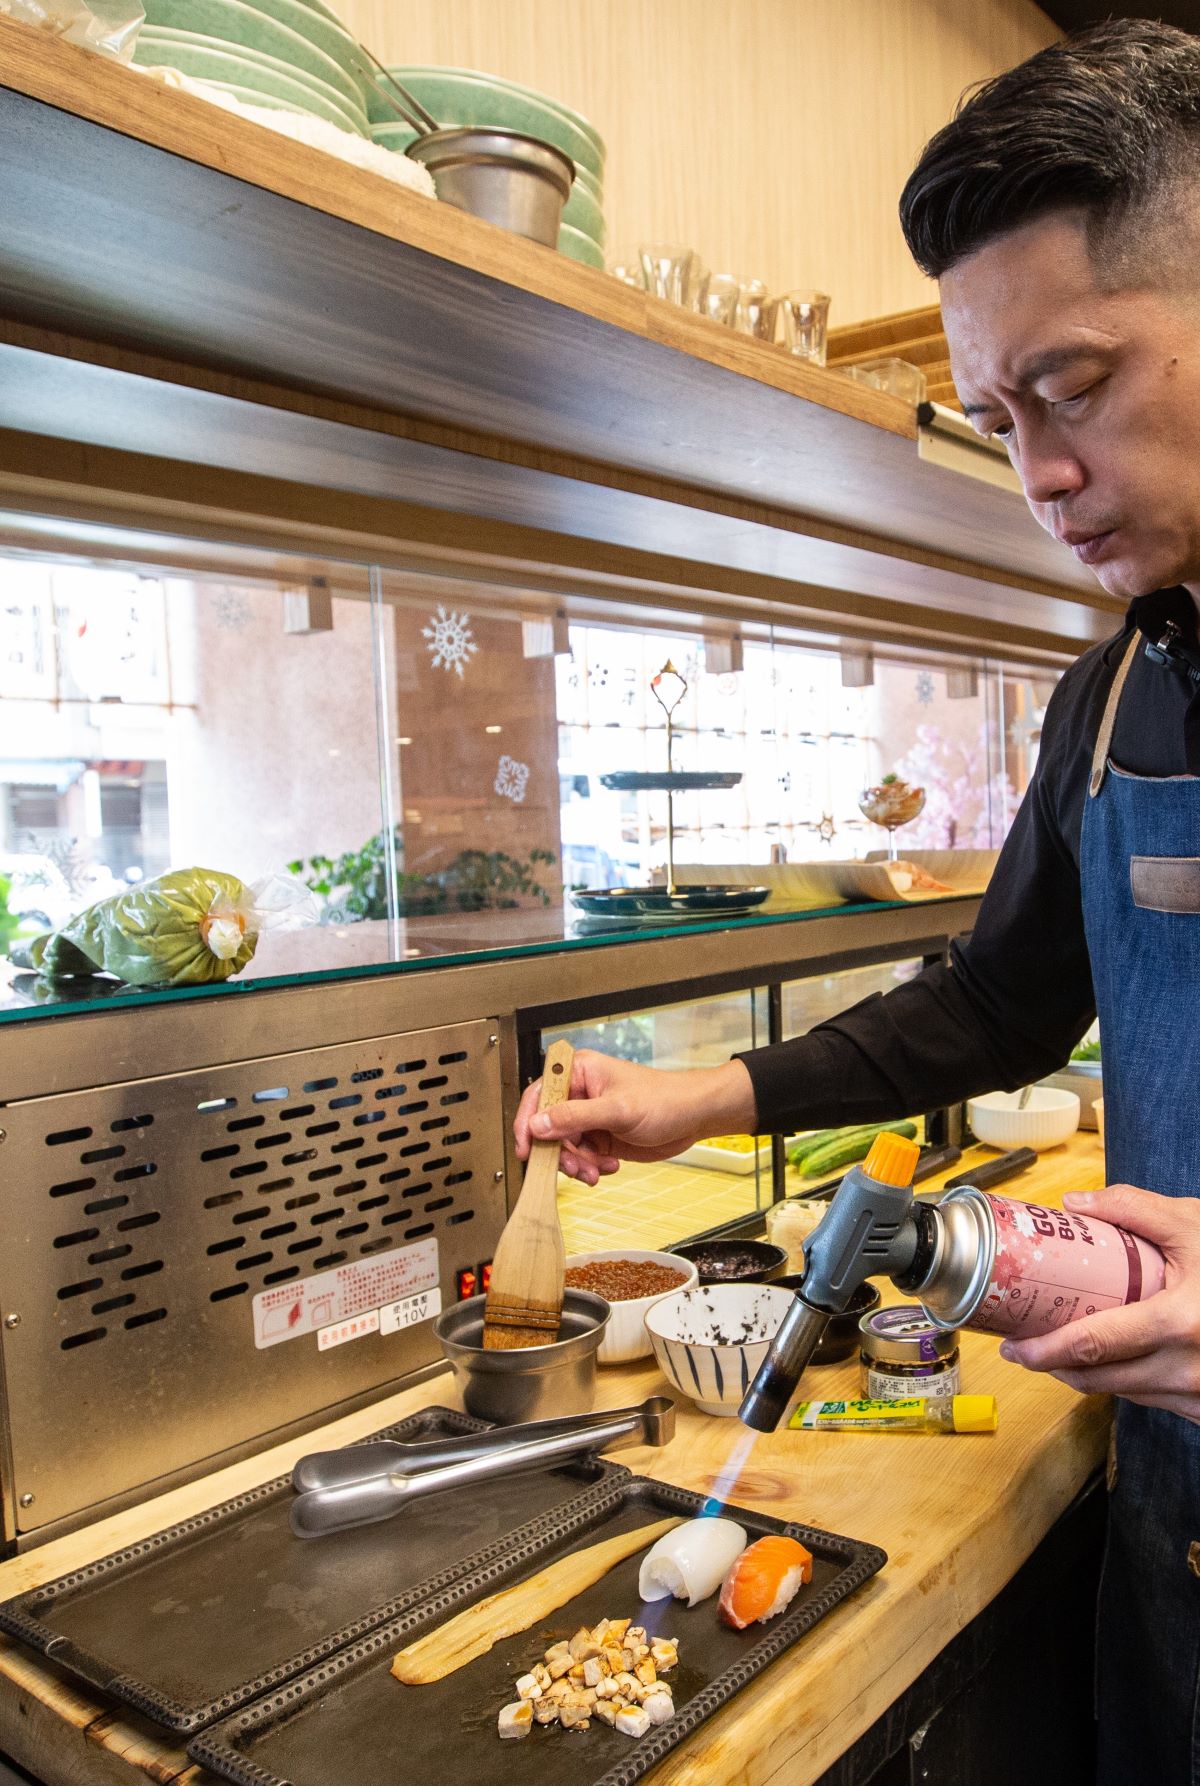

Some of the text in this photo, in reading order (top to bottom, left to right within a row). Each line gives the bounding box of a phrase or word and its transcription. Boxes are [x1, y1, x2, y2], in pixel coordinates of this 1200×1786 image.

[1026, 1203, 1055, 1237] GO
[1049, 1208, 1075, 1241] But
[395, 1305, 427, 1327] 110V
